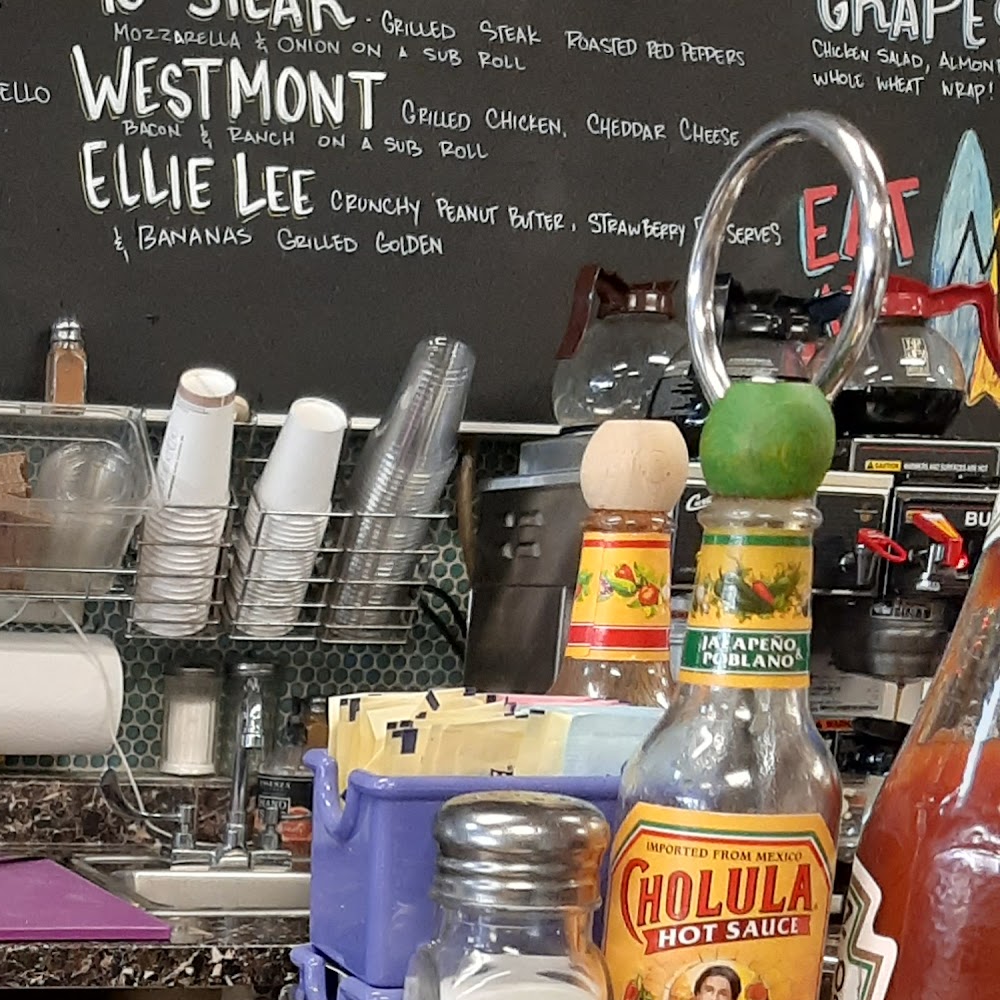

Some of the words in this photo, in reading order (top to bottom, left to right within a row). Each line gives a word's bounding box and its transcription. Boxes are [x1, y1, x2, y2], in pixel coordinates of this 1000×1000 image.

[381, 9, 456, 40] GRILLED
[479, 20, 542, 46] STEAK
[564, 30, 637, 57] ROASTED
[680, 41, 745, 67] PEPPERS
[817, 0, 987, 48] GRAPE
[114, 22, 241, 50] MOZZARELLA
[277, 36, 340, 55] ONION
[351, 41, 381, 58] ON
[398, 45, 408, 58] A
[422, 47, 462, 66] SUB
[477, 51, 526, 71] ROLL
[811, 38, 869, 63] CHICKEN
[72, 44, 387, 130] WESTMONT
[401, 98, 471, 132] GRILLED
[586, 112, 667, 141] CHEDDAR
[679, 117, 740, 147] CHEESE
[812, 69, 865, 89] WHOLE
[876, 75, 925, 96] WHEAT
[941, 80, 993, 105] WRAP!
[121, 119, 181, 138] BACON
[226, 126, 295, 146] RANCH
[317, 133, 345, 148] ON
[361, 136, 373, 151] A
[383, 136, 423, 157] SUB
[438, 140, 489, 160] ROLL
[81, 140, 215, 212] ELLIE
[232, 151, 316, 218] LEE
[330, 189, 421, 226] CRUNCHY
[435, 197, 499, 225] PEANUT
[587, 212, 686, 247] STRAWBERRY
[138, 224, 252, 251] BANANAS
[277, 227, 358, 253] GRILLED
[375, 230, 443, 256] GOLDEN
[702, 651, 795, 668] POBLANO
[646, 841, 709, 858] IMPORTED
[713, 850, 752, 862] FROM
[756, 851, 802, 863] MEXICO
[620, 858, 813, 945] CHOLULA
[658, 923, 718, 949] HOT
[725, 917, 799, 940] SAUCE
